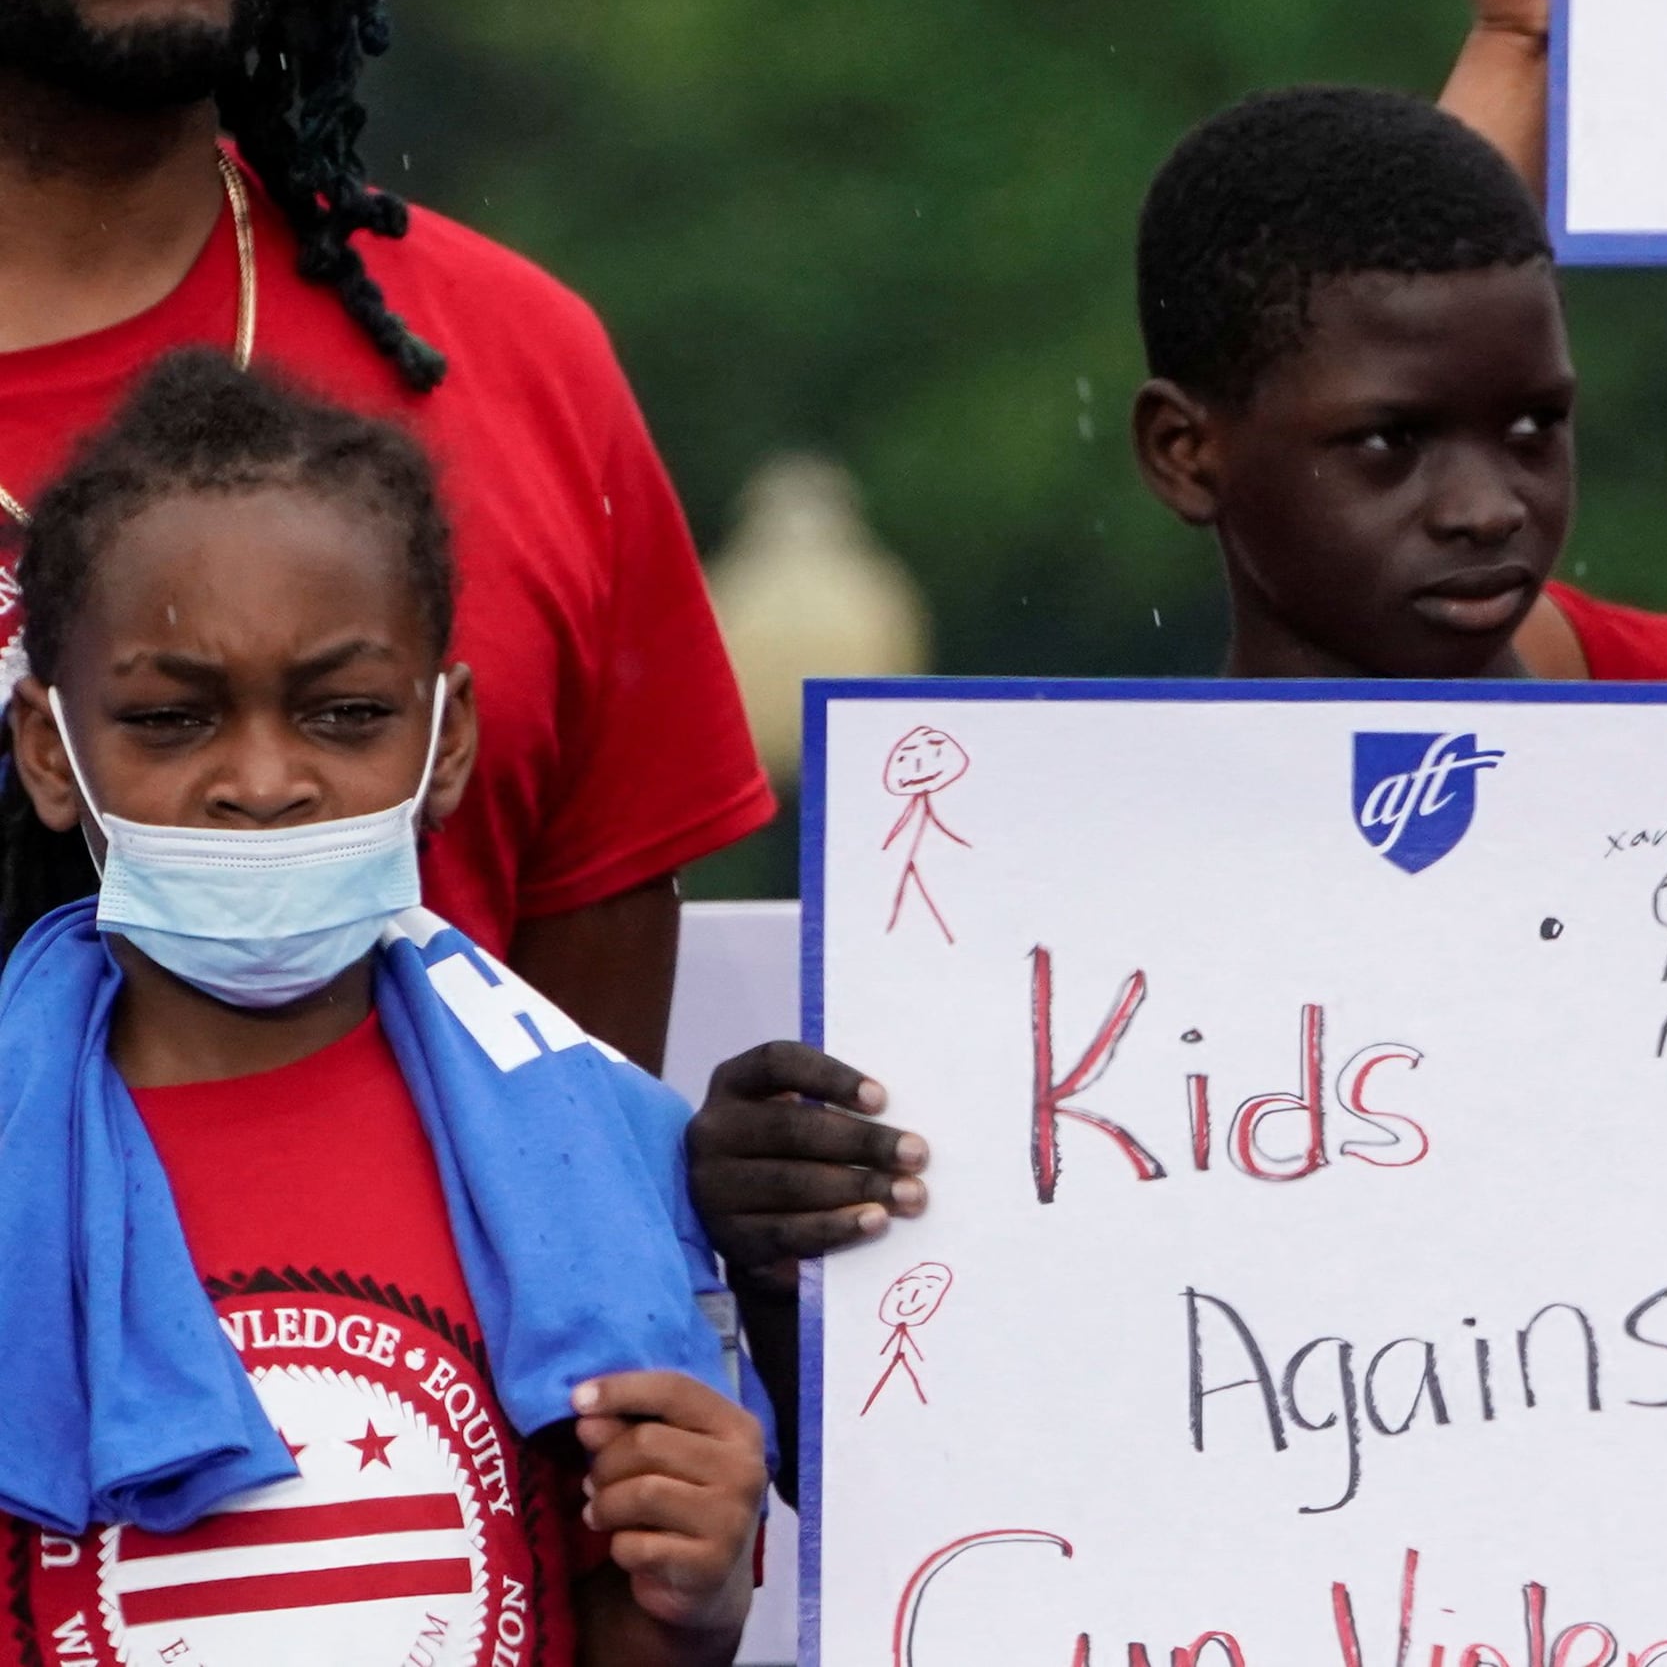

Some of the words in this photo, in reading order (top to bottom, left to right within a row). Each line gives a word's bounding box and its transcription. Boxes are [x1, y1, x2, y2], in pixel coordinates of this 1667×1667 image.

[1360, 731, 1505, 855] aft
[1027, 942, 1429, 1203] Kids
[419, 1357, 515, 1517] EQUITY
